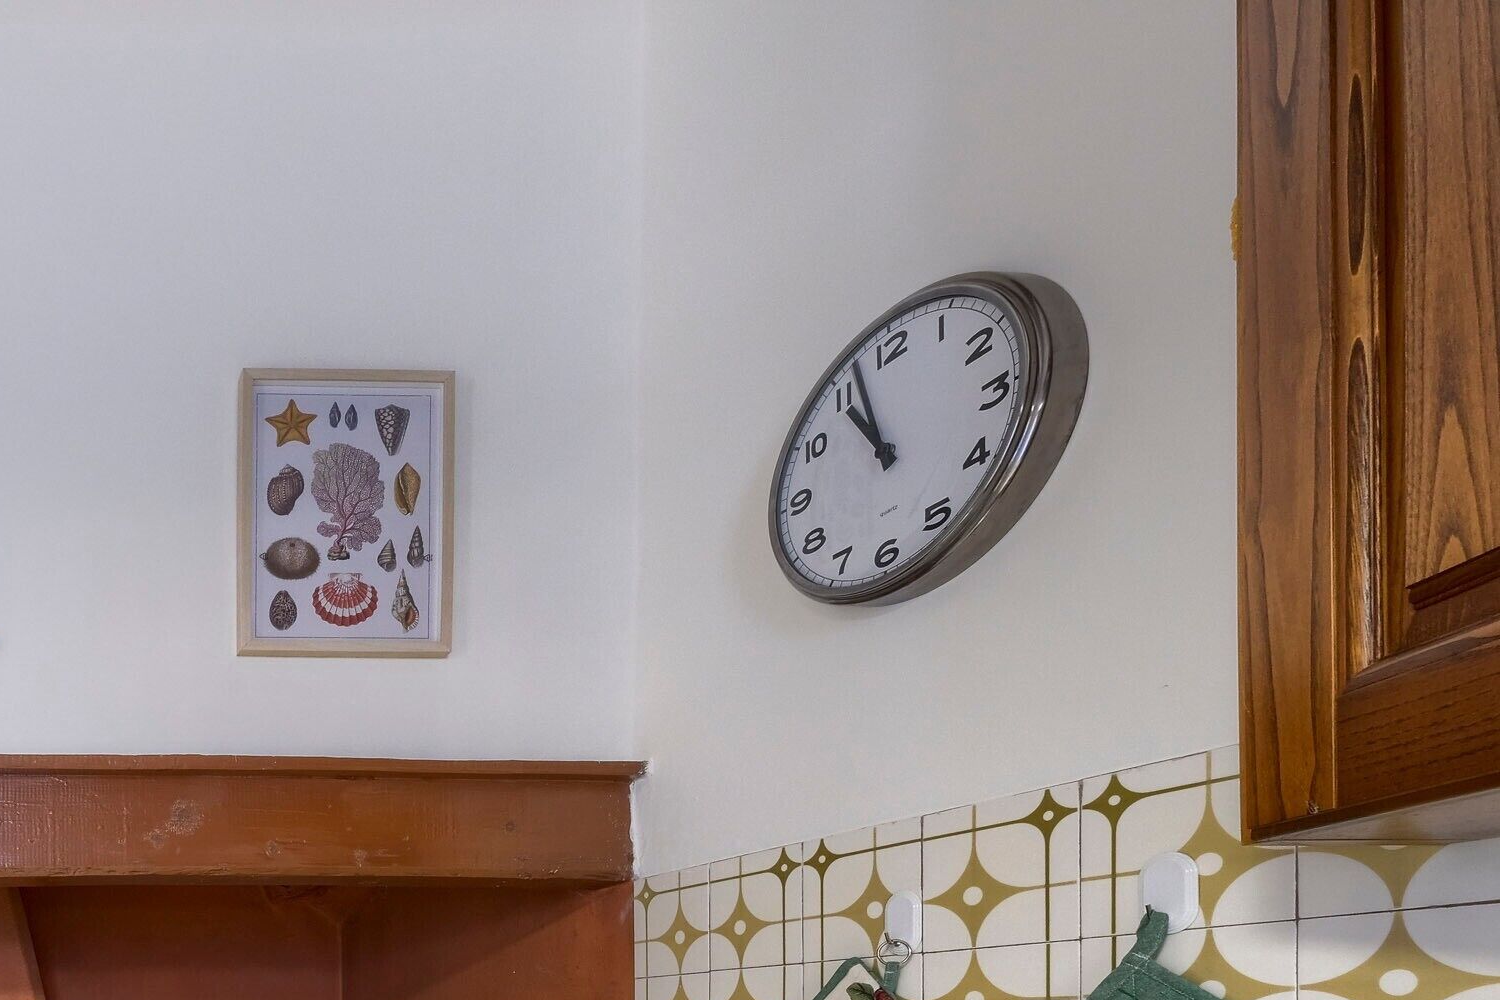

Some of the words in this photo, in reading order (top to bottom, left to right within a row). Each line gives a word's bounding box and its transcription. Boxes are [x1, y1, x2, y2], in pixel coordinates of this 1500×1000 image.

[937, 313, 946, 343] 1
[875, 330, 909, 371] 12
[964, 327, 994, 366] 2
[835, 381, 853, 413] 11
[978, 369, 1011, 412] 3
[804, 431, 828, 464] 10
[962, 436, 991, 471] 4
[789, 488, 812, 516] 9
[921, 496, 953, 532] 5
[801, 527, 826, 554] 8
[873, 538, 900, 568] 6
[832, 545, 853, 575] 7
